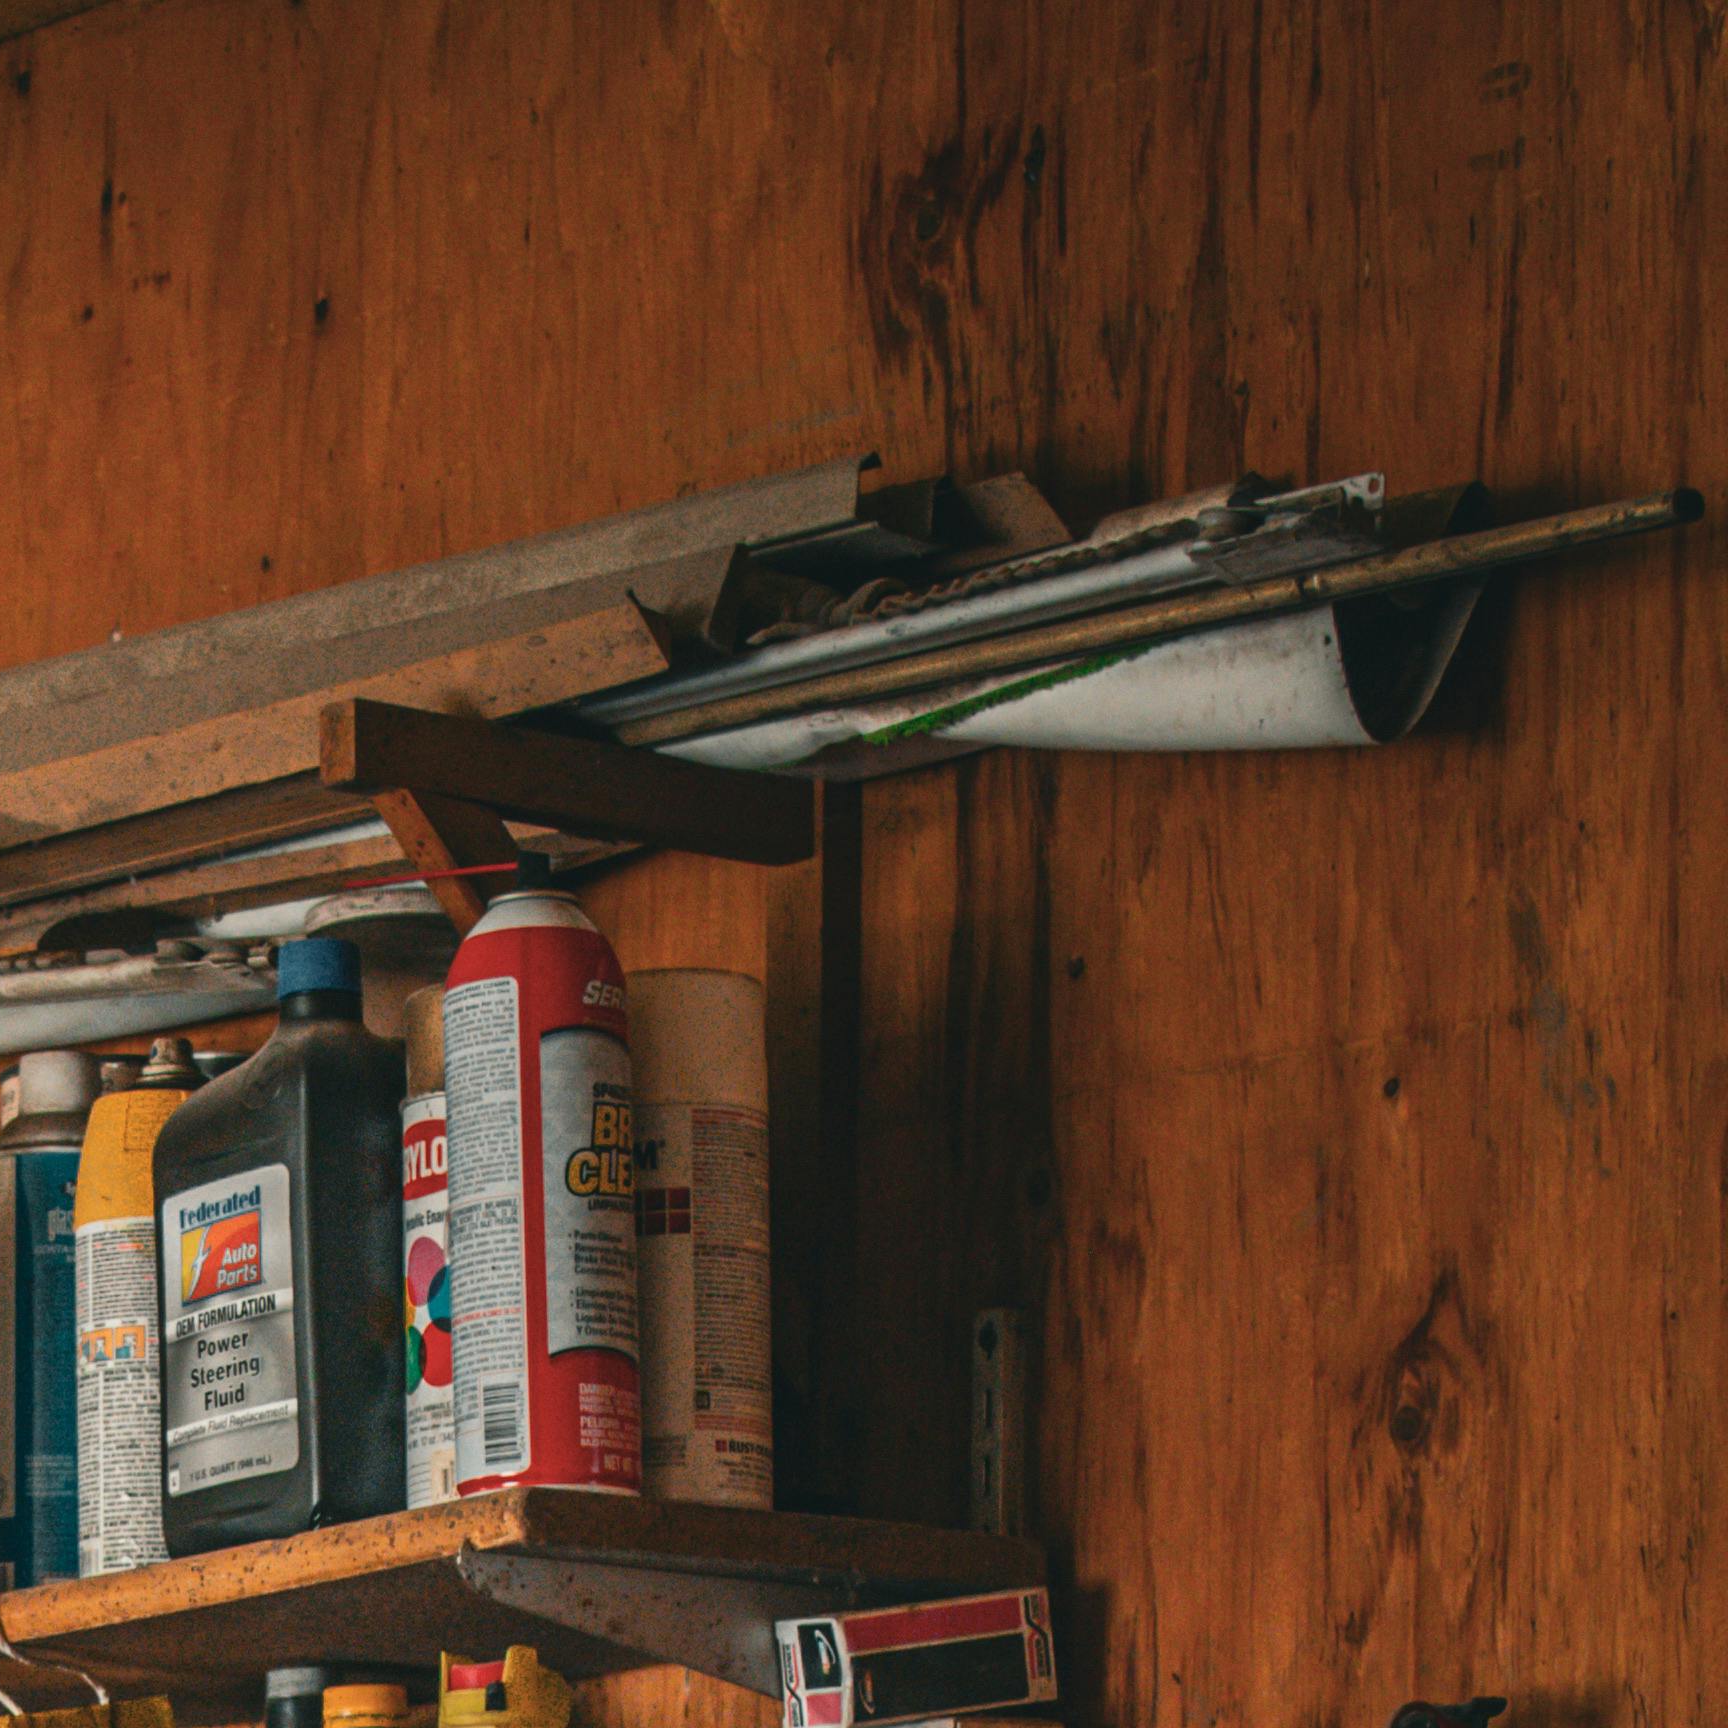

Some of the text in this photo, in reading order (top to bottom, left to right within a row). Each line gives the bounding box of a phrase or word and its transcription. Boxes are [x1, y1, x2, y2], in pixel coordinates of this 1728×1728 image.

[179, 1184, 261, 1230] Federated
[222, 1242, 257, 1266] Auto
[216, 1264, 258, 1288] Parts
[176, 1293, 277, 1338] OEM FORMULATION
[197, 1332, 249, 1358] Power
[190, 1356, 261, 1389] Steering
[204, 1382, 246, 1411] Fluid
[229, 1404, 290, 1429] Replacement
[209, 1460, 236, 1477] QUART
